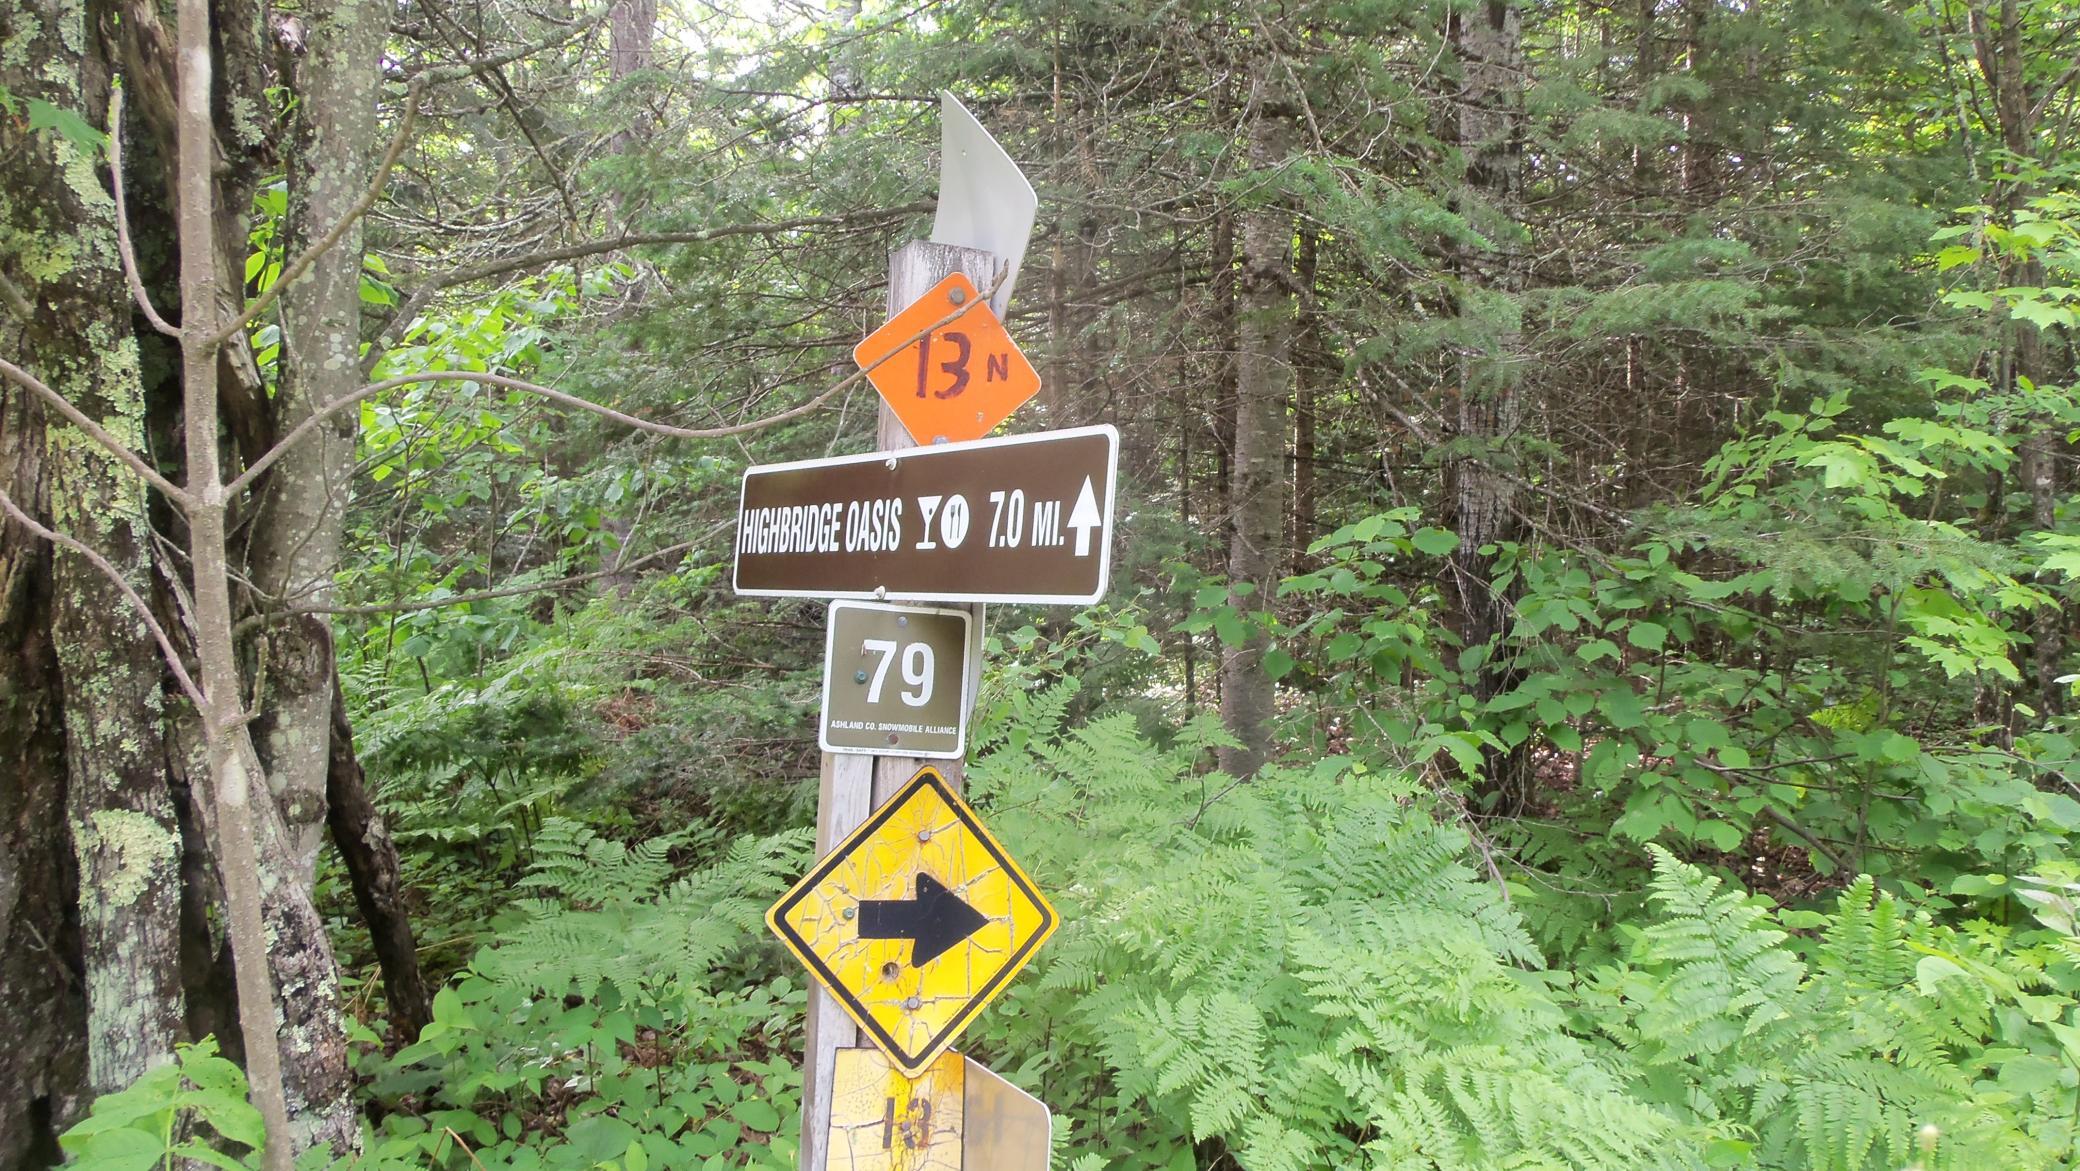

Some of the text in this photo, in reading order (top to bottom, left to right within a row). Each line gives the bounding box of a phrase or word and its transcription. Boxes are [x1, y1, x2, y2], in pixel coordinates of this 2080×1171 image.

[914, 330, 1009, 400] 13 N
[741, 489, 1066, 553] HIGHBRIDGE OASIS 7.0 MI.
[863, 639, 935, 707] 79
[830, 719, 957, 735] ASHLAND CO. SNOWMOBILE ALLIANCE
